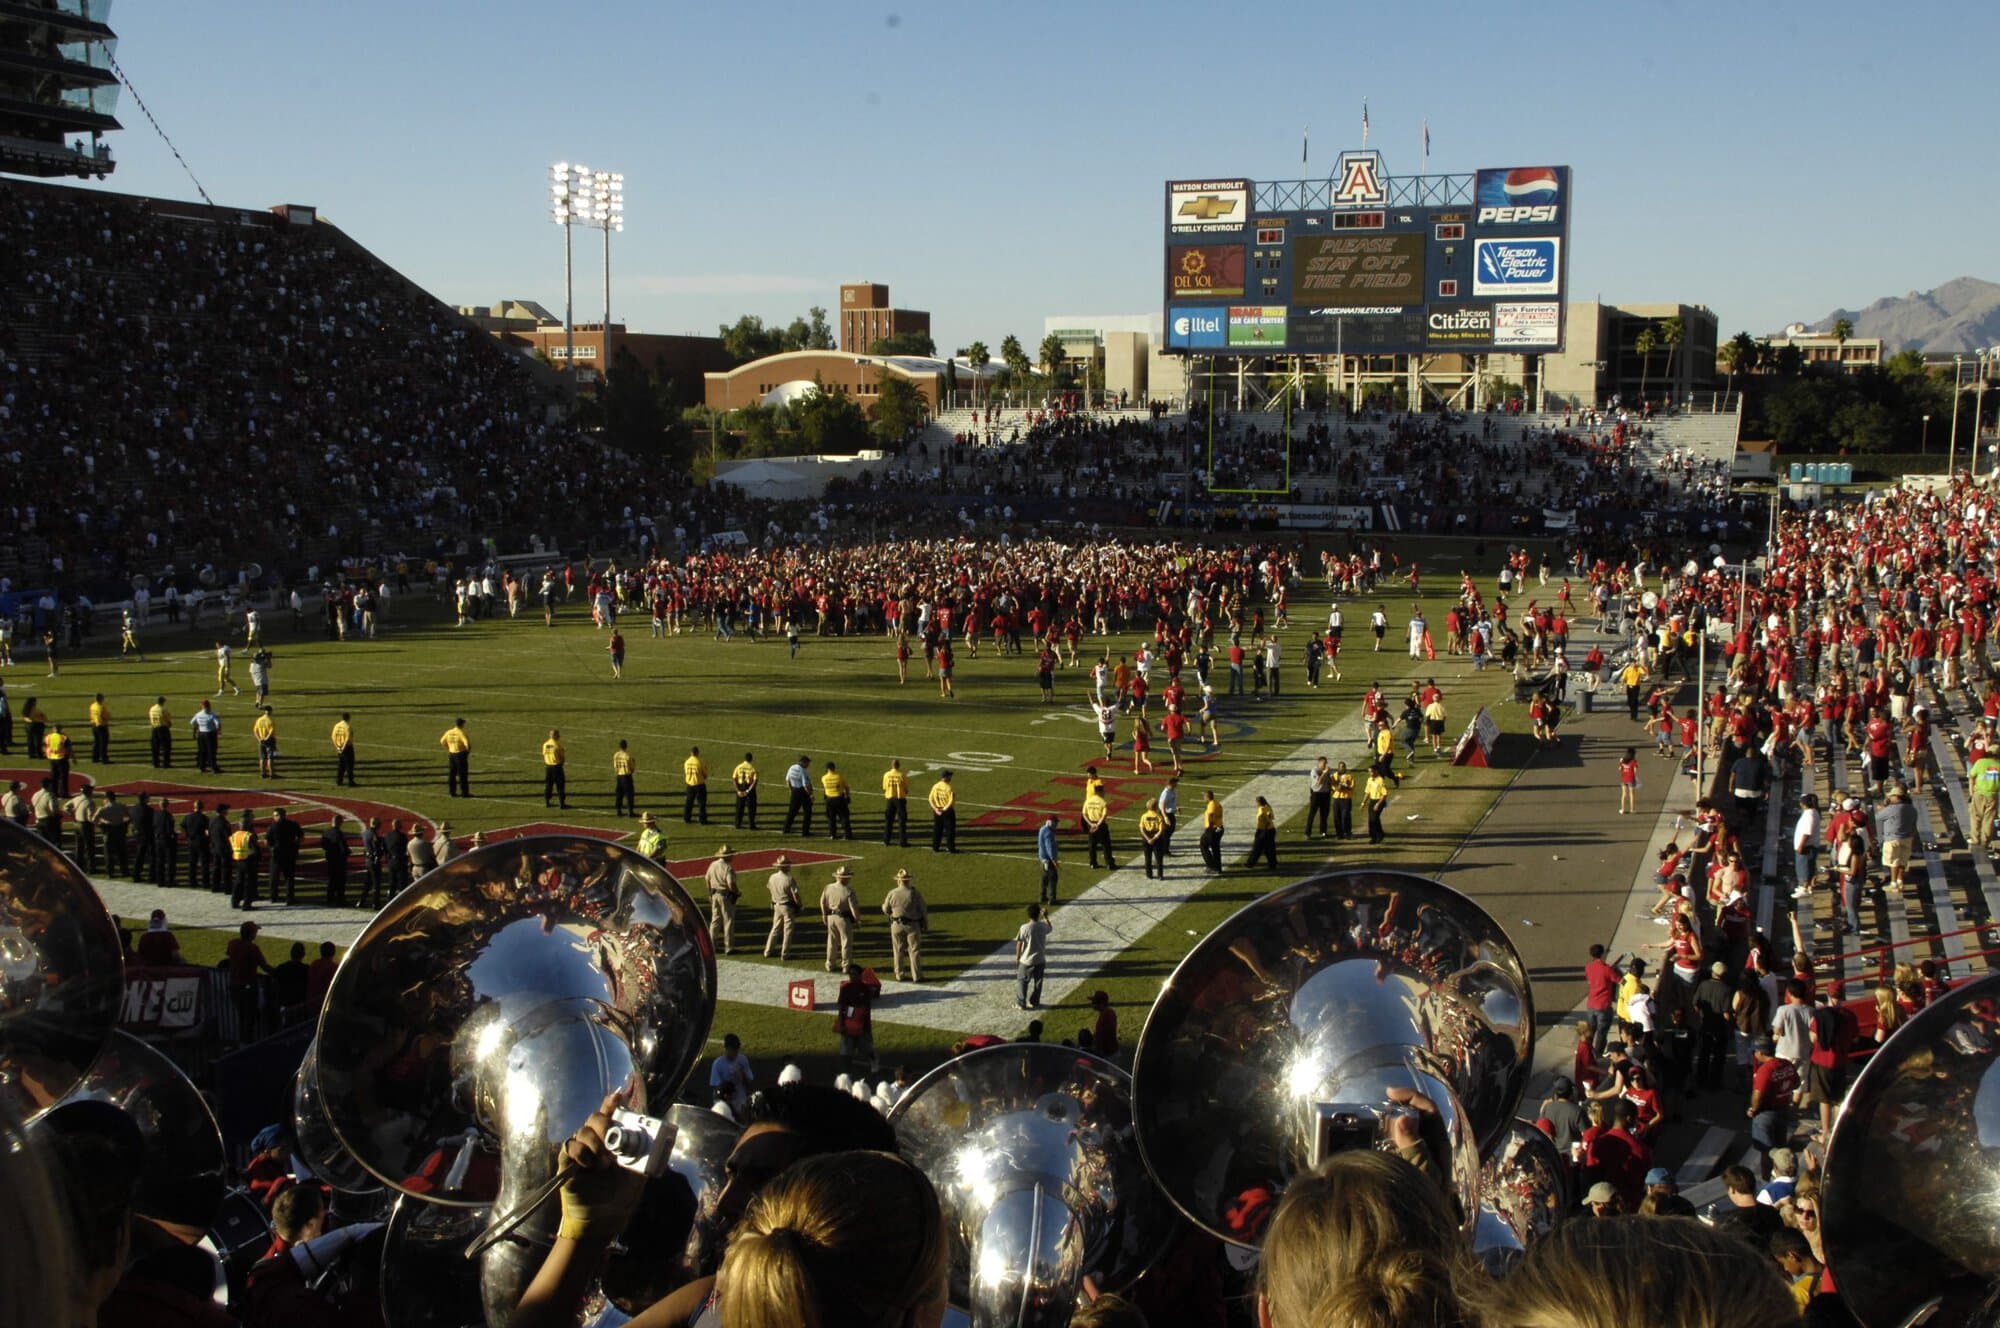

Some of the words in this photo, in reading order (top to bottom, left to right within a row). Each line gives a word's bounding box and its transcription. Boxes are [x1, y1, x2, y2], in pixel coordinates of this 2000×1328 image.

[1202, 182, 1244, 190] CHEVROLET
[1478, 206, 1557, 224] PEPSI
[1202, 224, 1243, 232] CHEVROLET
[1320, 238, 1398, 254] PLEASE
[1497, 246, 1537, 258] Tucson
[1306, 256, 1358, 271] STAY
[1361, 255, 1410, 271] OFF
[1501, 257, 1547, 268] Electric
[1505, 267, 1546, 278] Power
[1174, 275, 1191, 288] DEL
[1195, 275, 1212, 287] SOL
[1302, 274, 1346, 288] THE
[1349, 272, 1412, 288] FIELD
[1322, 307, 1403, 315] ARIZONAATHLETICS.COM
[1458, 308, 1490, 318] Tucson
[1520, 305, 1556, 313] Furrier's
[1429, 313, 1491, 329] Citizen
